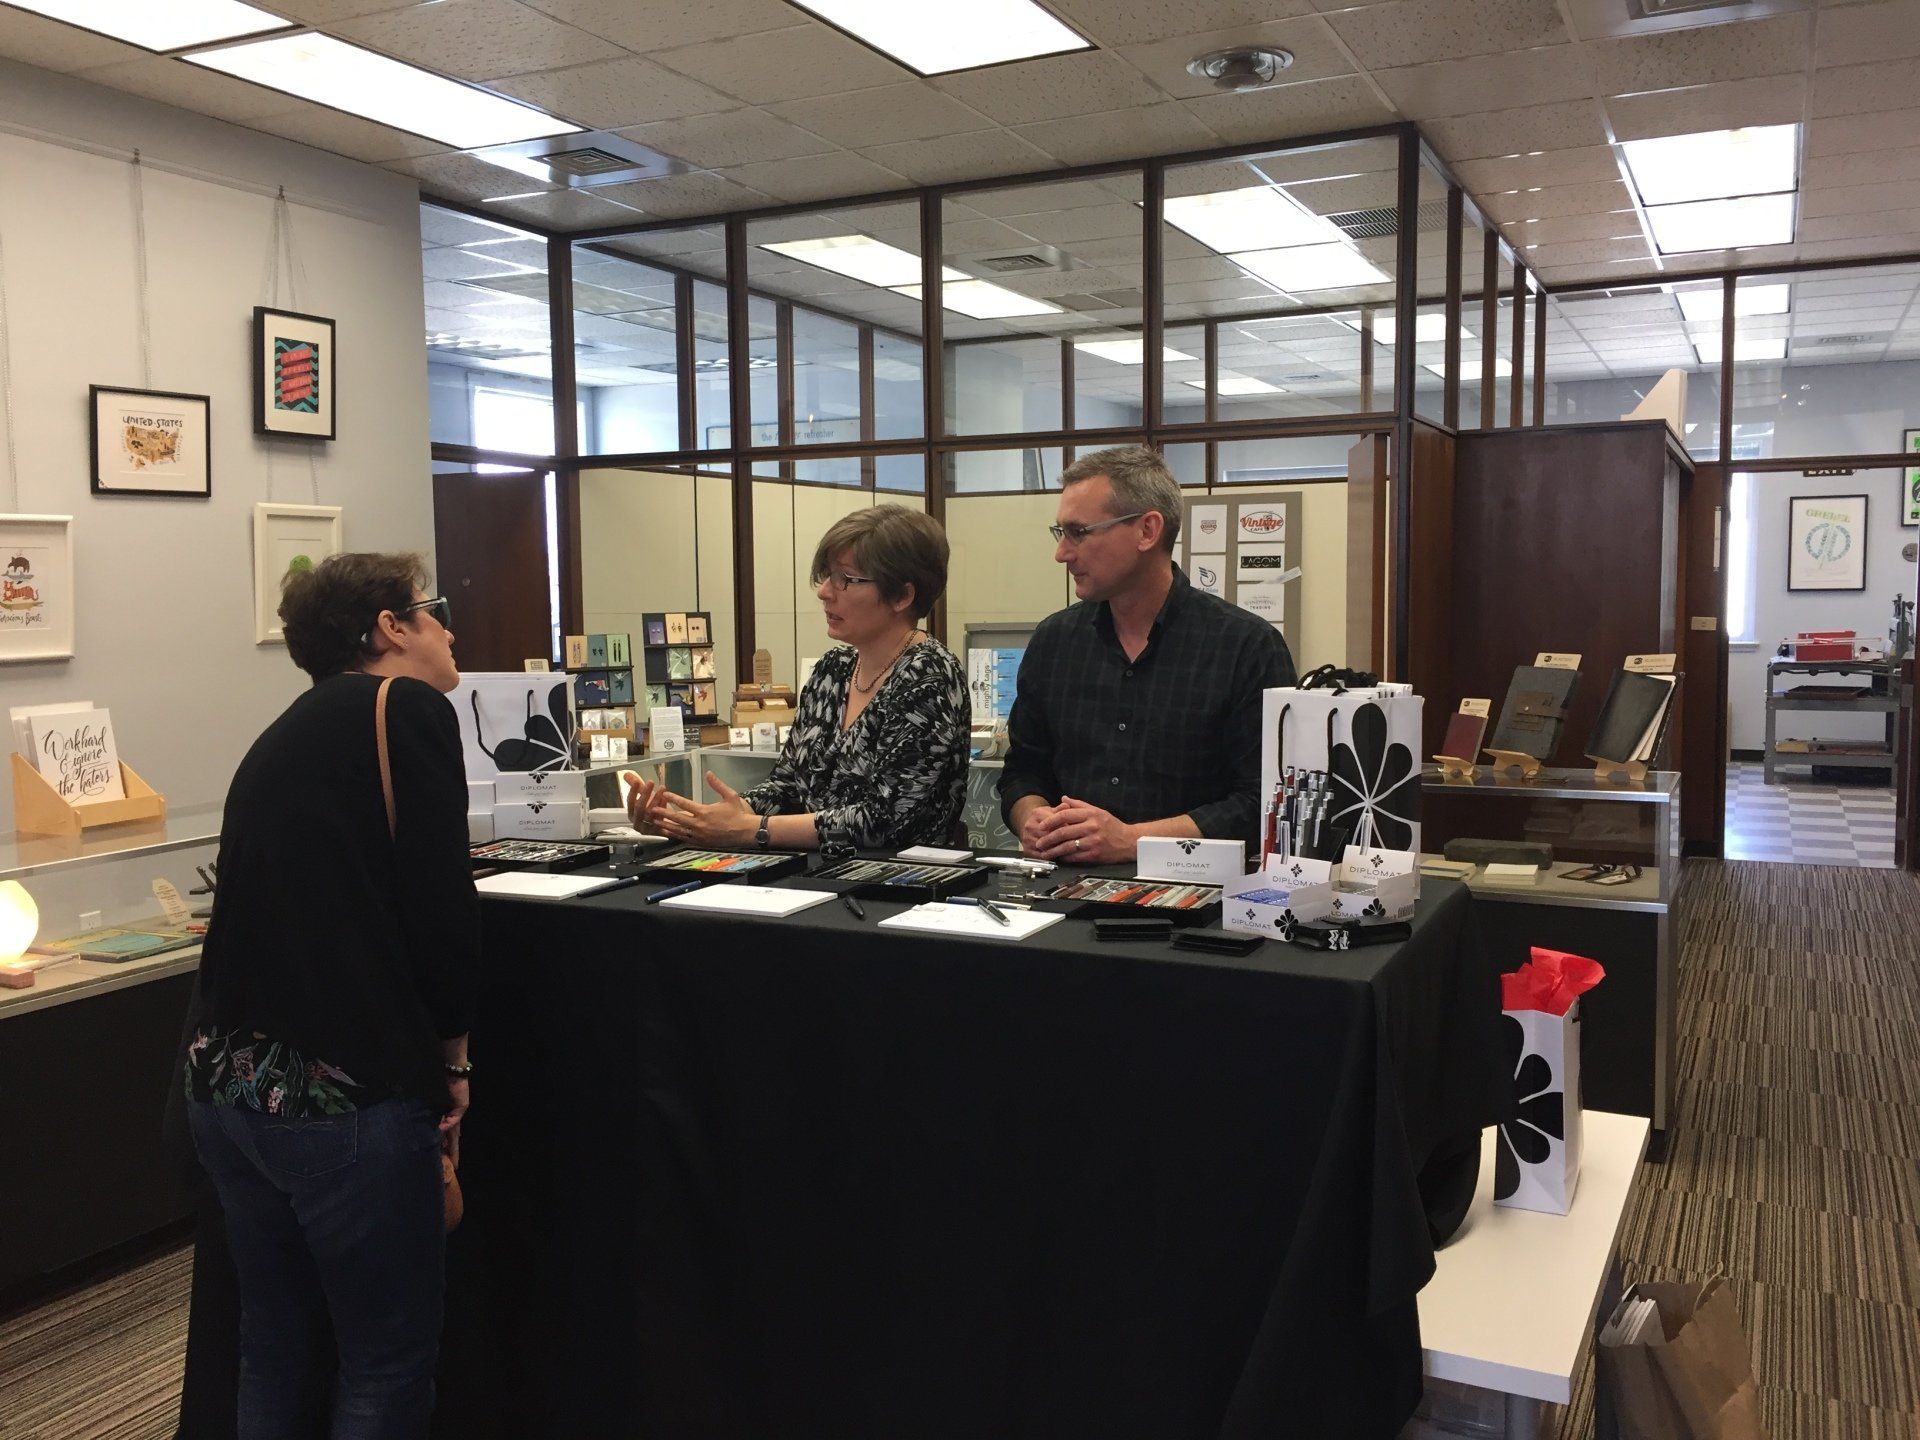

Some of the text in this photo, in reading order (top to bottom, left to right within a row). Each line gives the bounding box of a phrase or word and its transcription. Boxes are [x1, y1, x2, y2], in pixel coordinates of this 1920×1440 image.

[1240, 517, 1283, 529] Vintage
[1241, 557, 1280, 568] LAGOM
[984, 683, 992, 709] mighty
[56, 769, 112, 796] the haters
[1166, 861, 1211, 869] DIPLOMAT
[1331, 911, 1359, 919] LOMAT
[1231, 918, 1272, 930] DIPLOMAT
